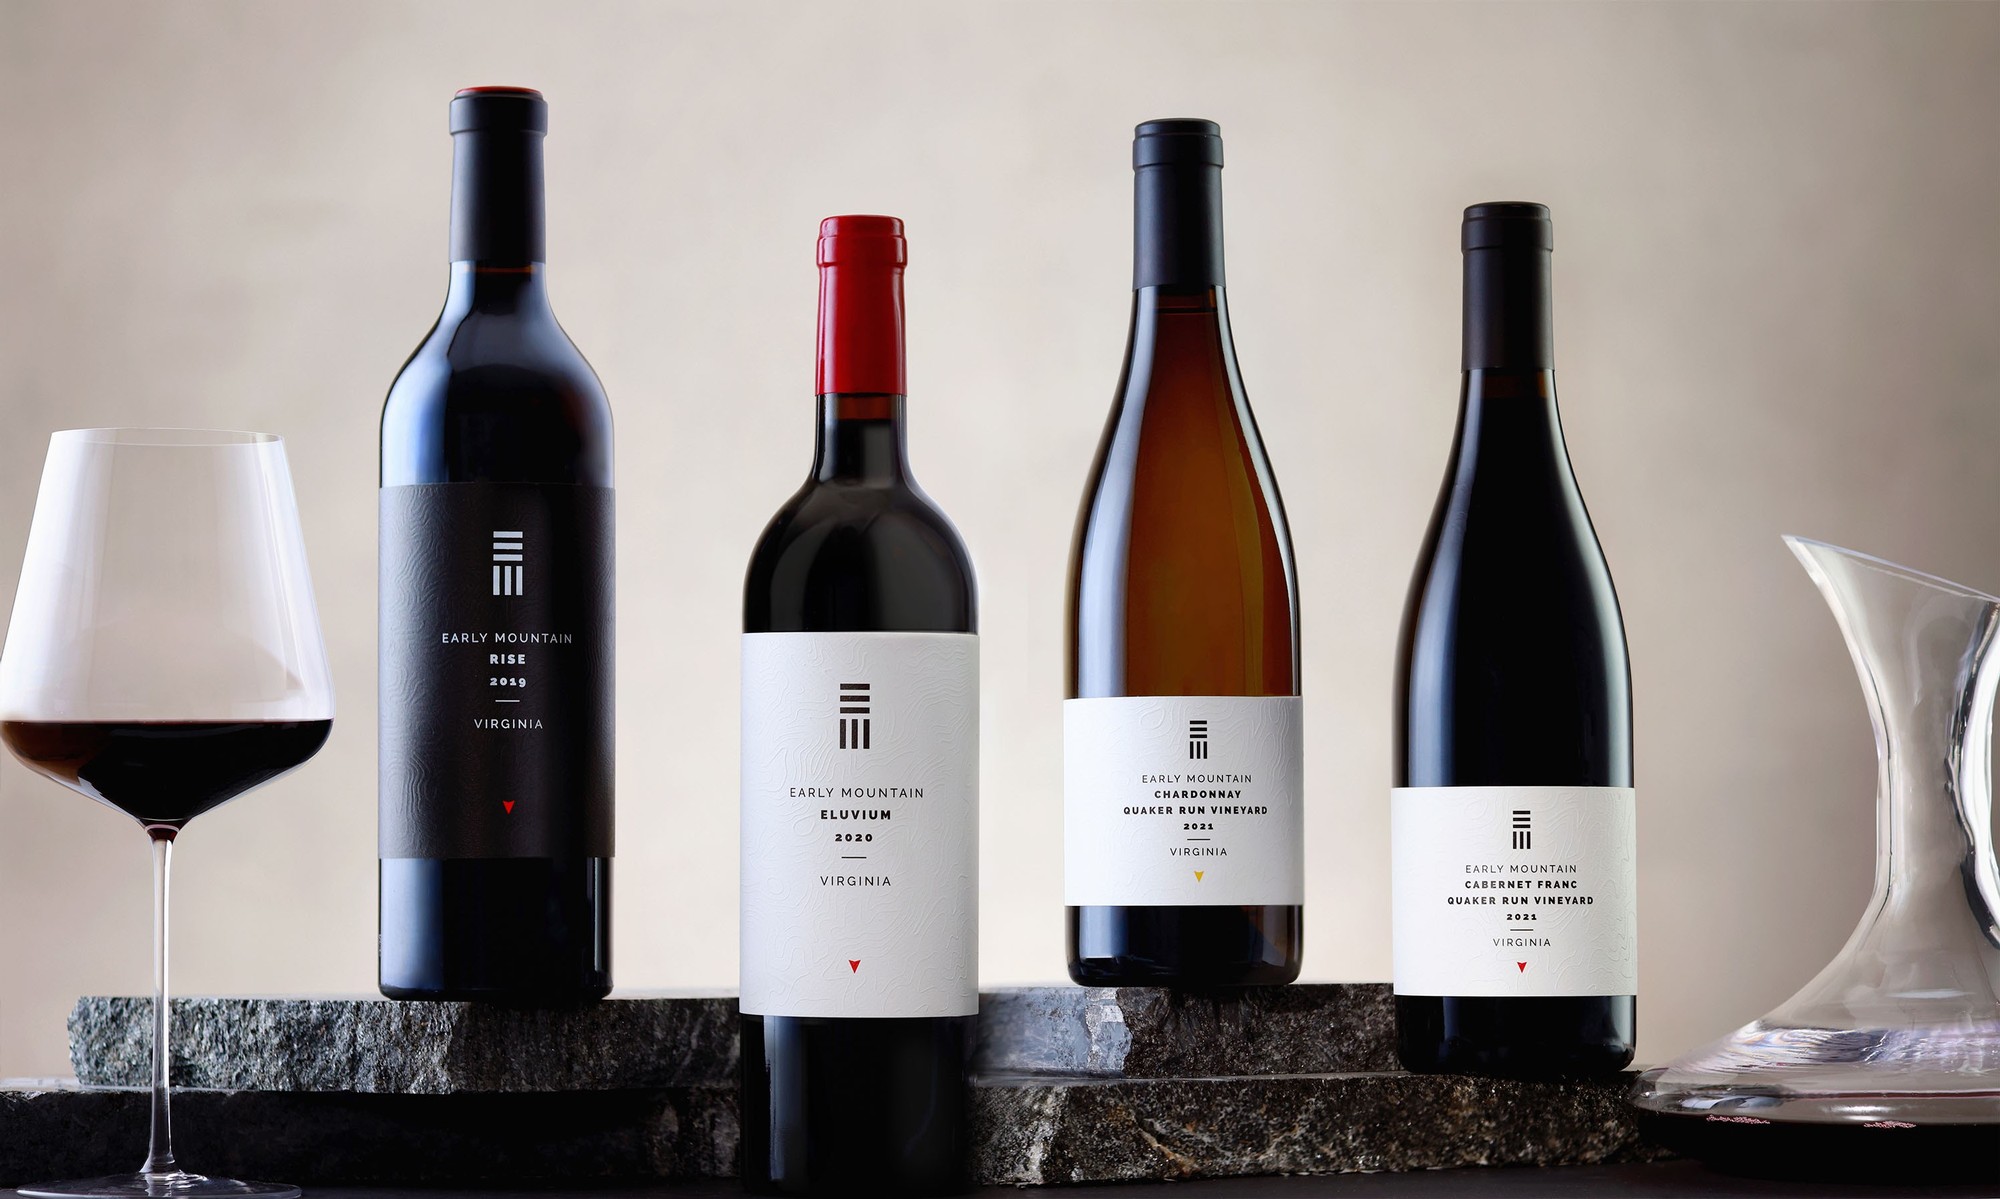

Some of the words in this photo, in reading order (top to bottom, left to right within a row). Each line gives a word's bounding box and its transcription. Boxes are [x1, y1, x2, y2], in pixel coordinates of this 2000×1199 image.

[442, 632, 488, 644] EARLY
[495, 632, 572, 644] MOUNTAIN
[489, 653, 526, 665] RISE
[489, 677, 527, 688] 2019
[473, 718, 543, 730] VIRGINIA
[1142, 774, 1181, 784] EARLY
[1186, 774, 1252, 784] MOUNTAIN
[790, 787, 834, 798] EARLY
[841, 787, 924, 799] MOUNTAIN
[1154, 789, 1242, 799] CHARDONNAY
[820, 809, 891, 821] ELUVIUM
[1123, 806, 1173, 815] QUAKER
[1179, 805, 1205, 815] RUN
[1210, 805, 1268, 815] VINEYARD
[1183, 822, 1214, 831] 2021
[834, 833, 873, 843] 2020
[1169, 847, 1228, 857] VIRGINIA
[1465, 864, 1504, 874] EARLY
[1510, 864, 1577, 874] MOUNTAIN
[820, 875, 892, 887] VIRGINIA
[1464, 880, 1532, 889] CABERNET
[1537, 880, 1578, 889] FRANC
[1447, 896, 1496, 905] QUAKER
[1502, 896, 1528, 905] RUN
[1533, 896, 1594, 905] VINEYARD
[1506, 913, 1537, 921] 2021
[1492, 937, 1551, 947] VIRGINIA
